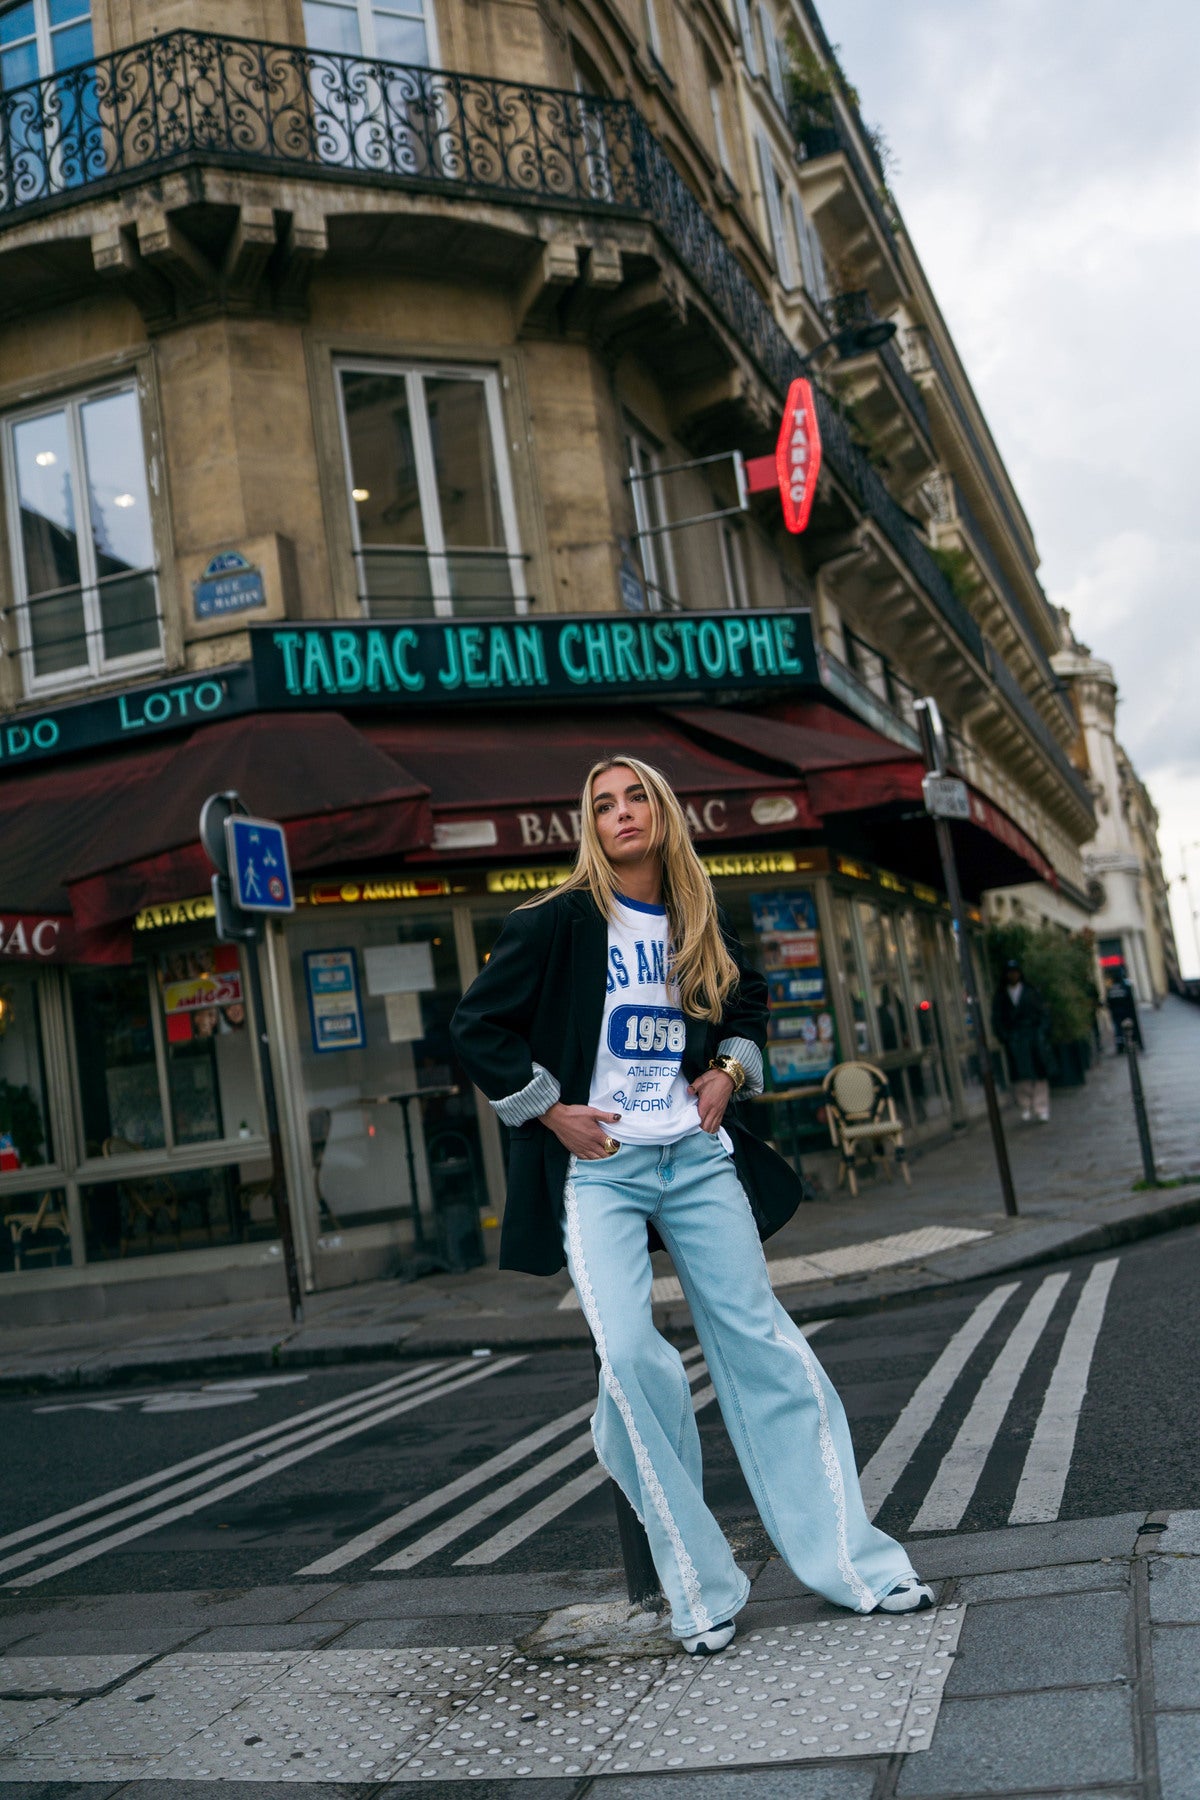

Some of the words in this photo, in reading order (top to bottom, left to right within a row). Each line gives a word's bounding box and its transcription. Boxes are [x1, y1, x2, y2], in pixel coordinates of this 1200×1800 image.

[790, 408, 808, 503] TABAC
[274, 628, 424, 695] TABAC
[439, 623, 549, 689] JEAN
[559, 617, 802, 682] CHRISTOPHE
[0, 918, 61, 957] AC
[624, 1015, 686, 1053] 1958
[626, 1066, 678, 1077] ATHLETICS
[635, 1082, 661, 1093] DEPT.
